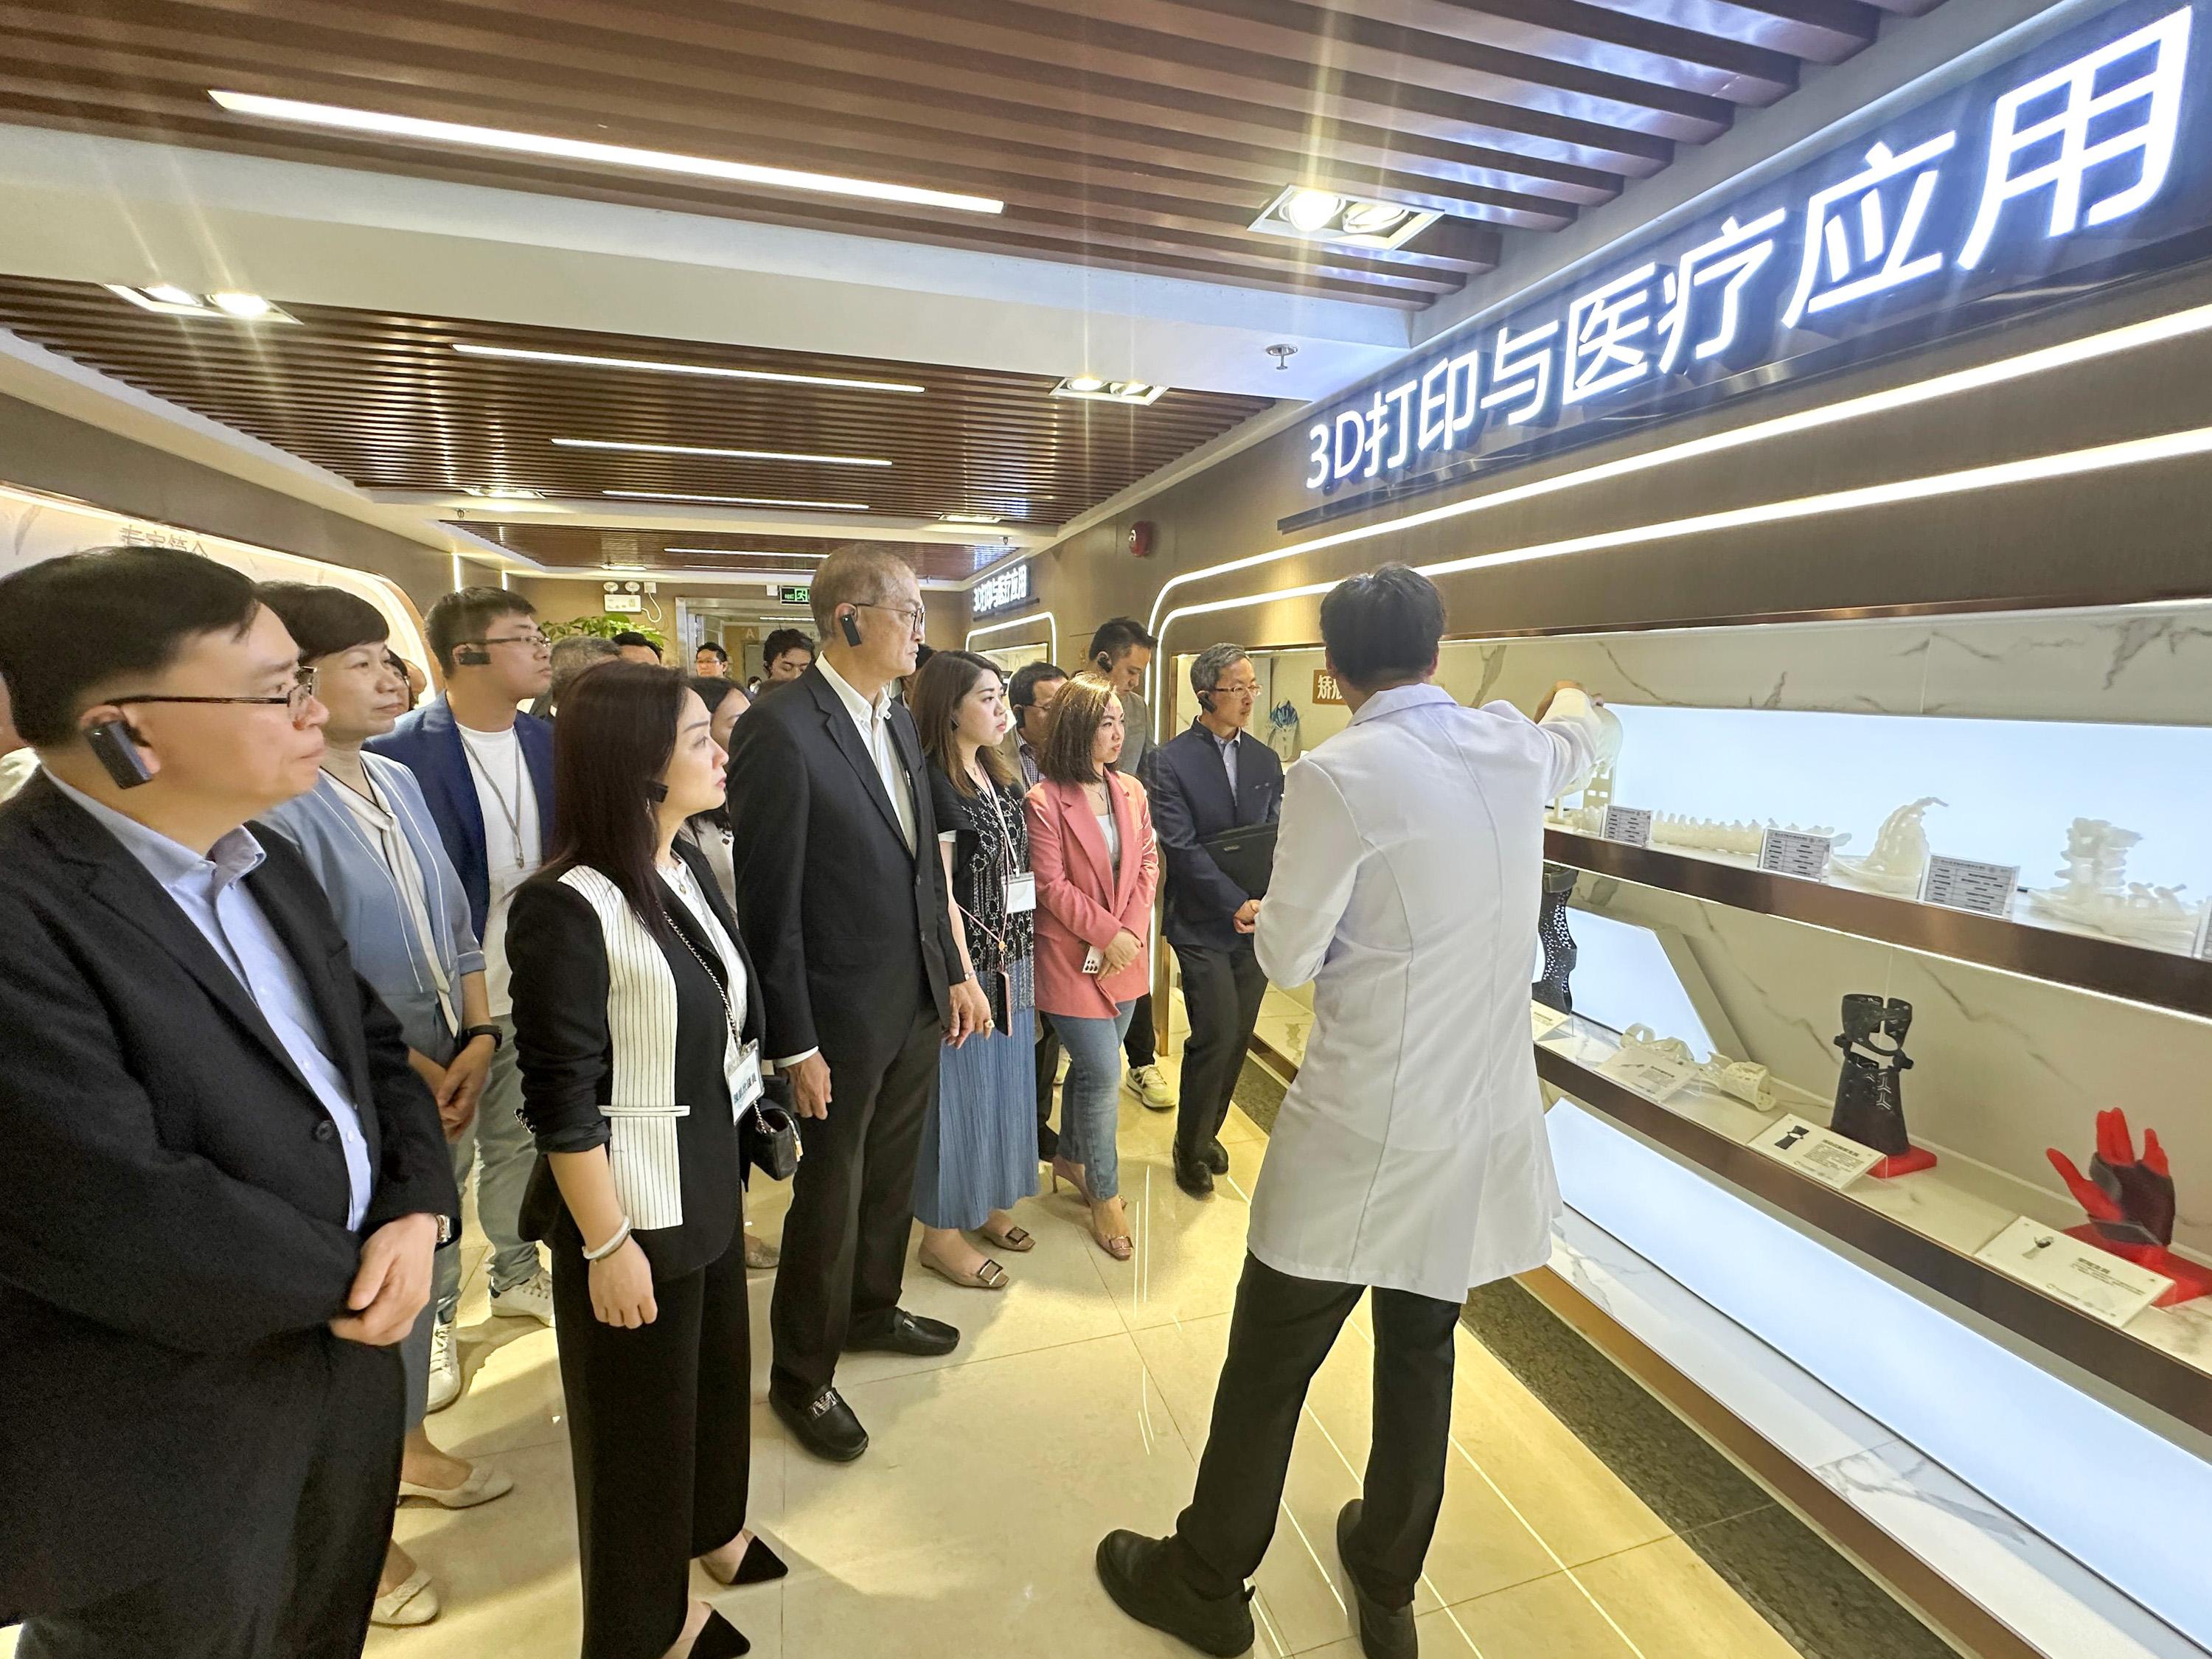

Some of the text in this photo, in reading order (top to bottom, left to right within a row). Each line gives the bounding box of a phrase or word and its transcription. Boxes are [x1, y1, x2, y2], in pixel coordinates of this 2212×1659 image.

[1305, 4, 2194, 489] 3D打印与医疗应用
